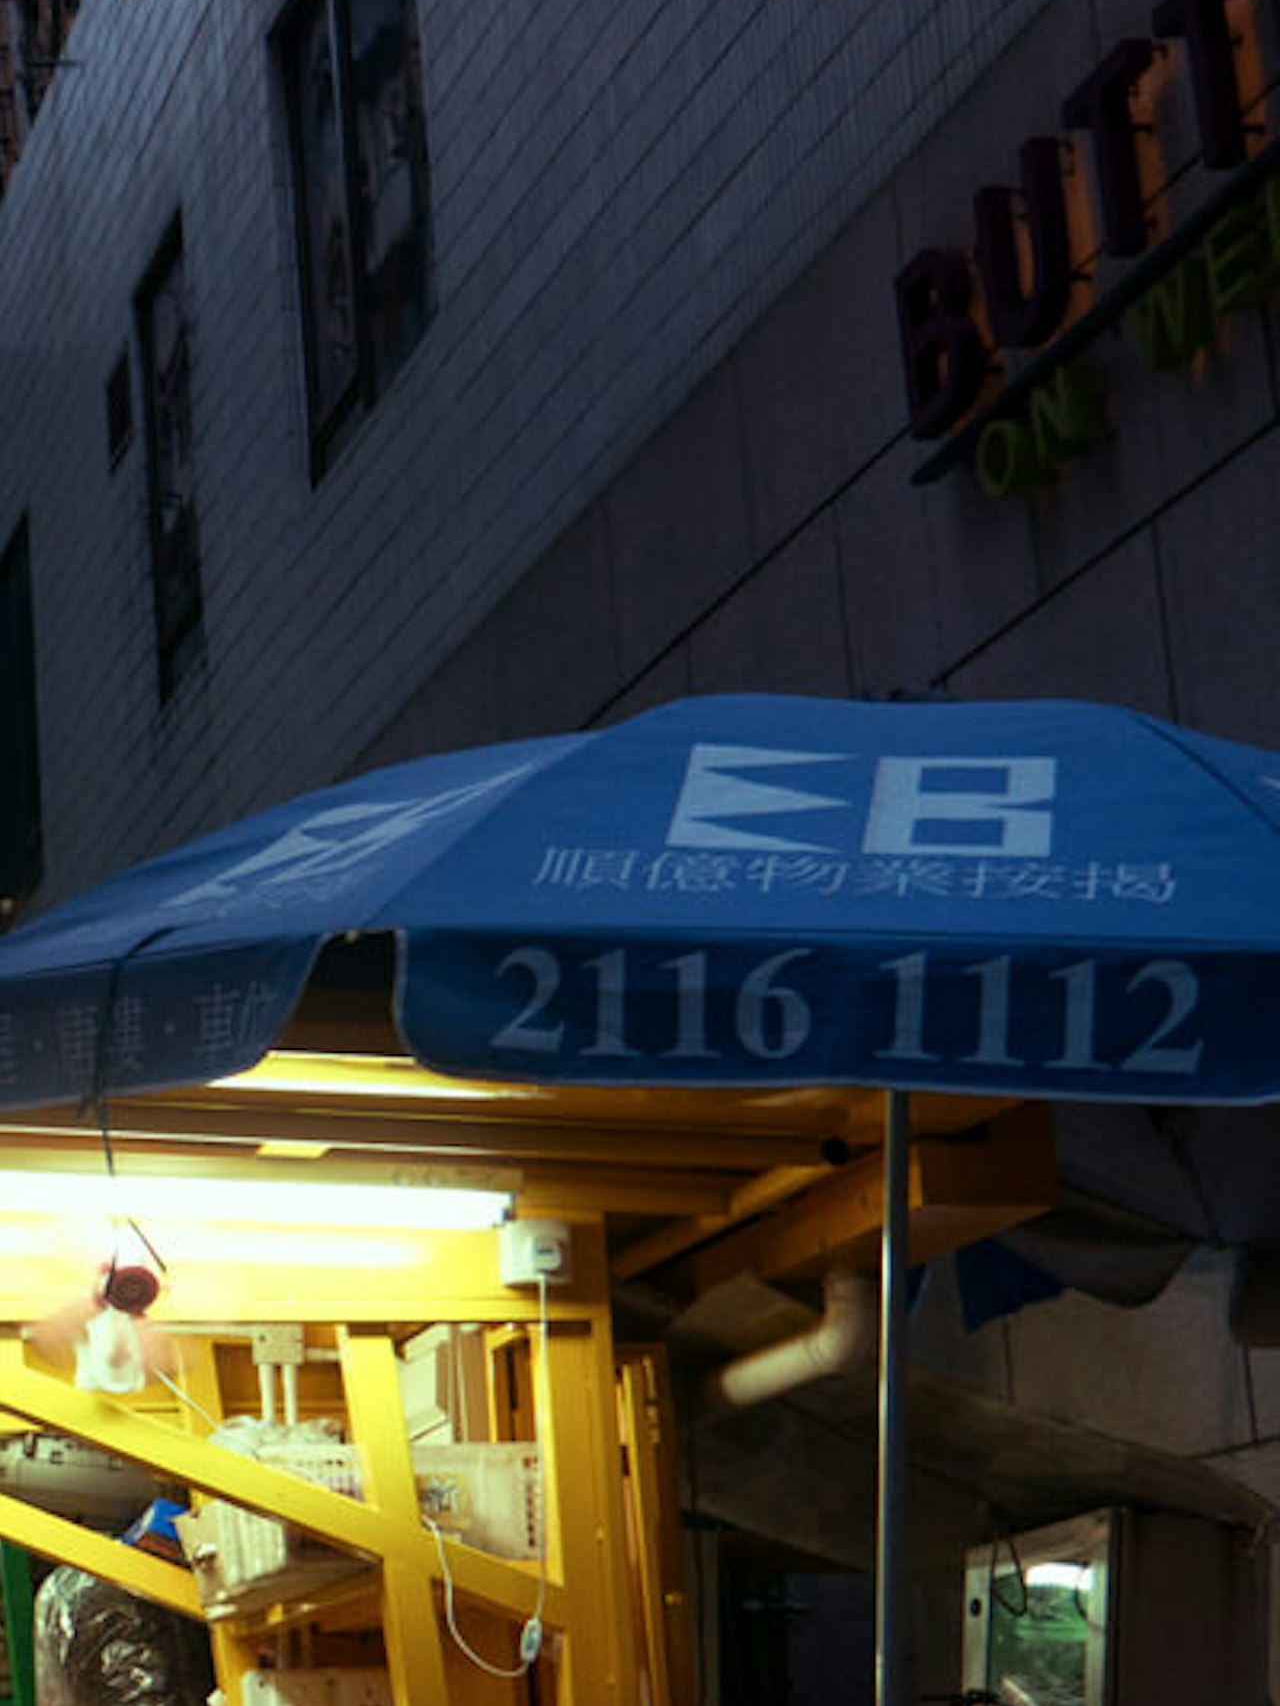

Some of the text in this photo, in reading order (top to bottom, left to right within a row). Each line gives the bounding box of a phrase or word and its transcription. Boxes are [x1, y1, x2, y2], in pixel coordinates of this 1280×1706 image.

[1127, 180, 1280, 376] WE
[489, 945, 1206, 1076] 2116 1112
